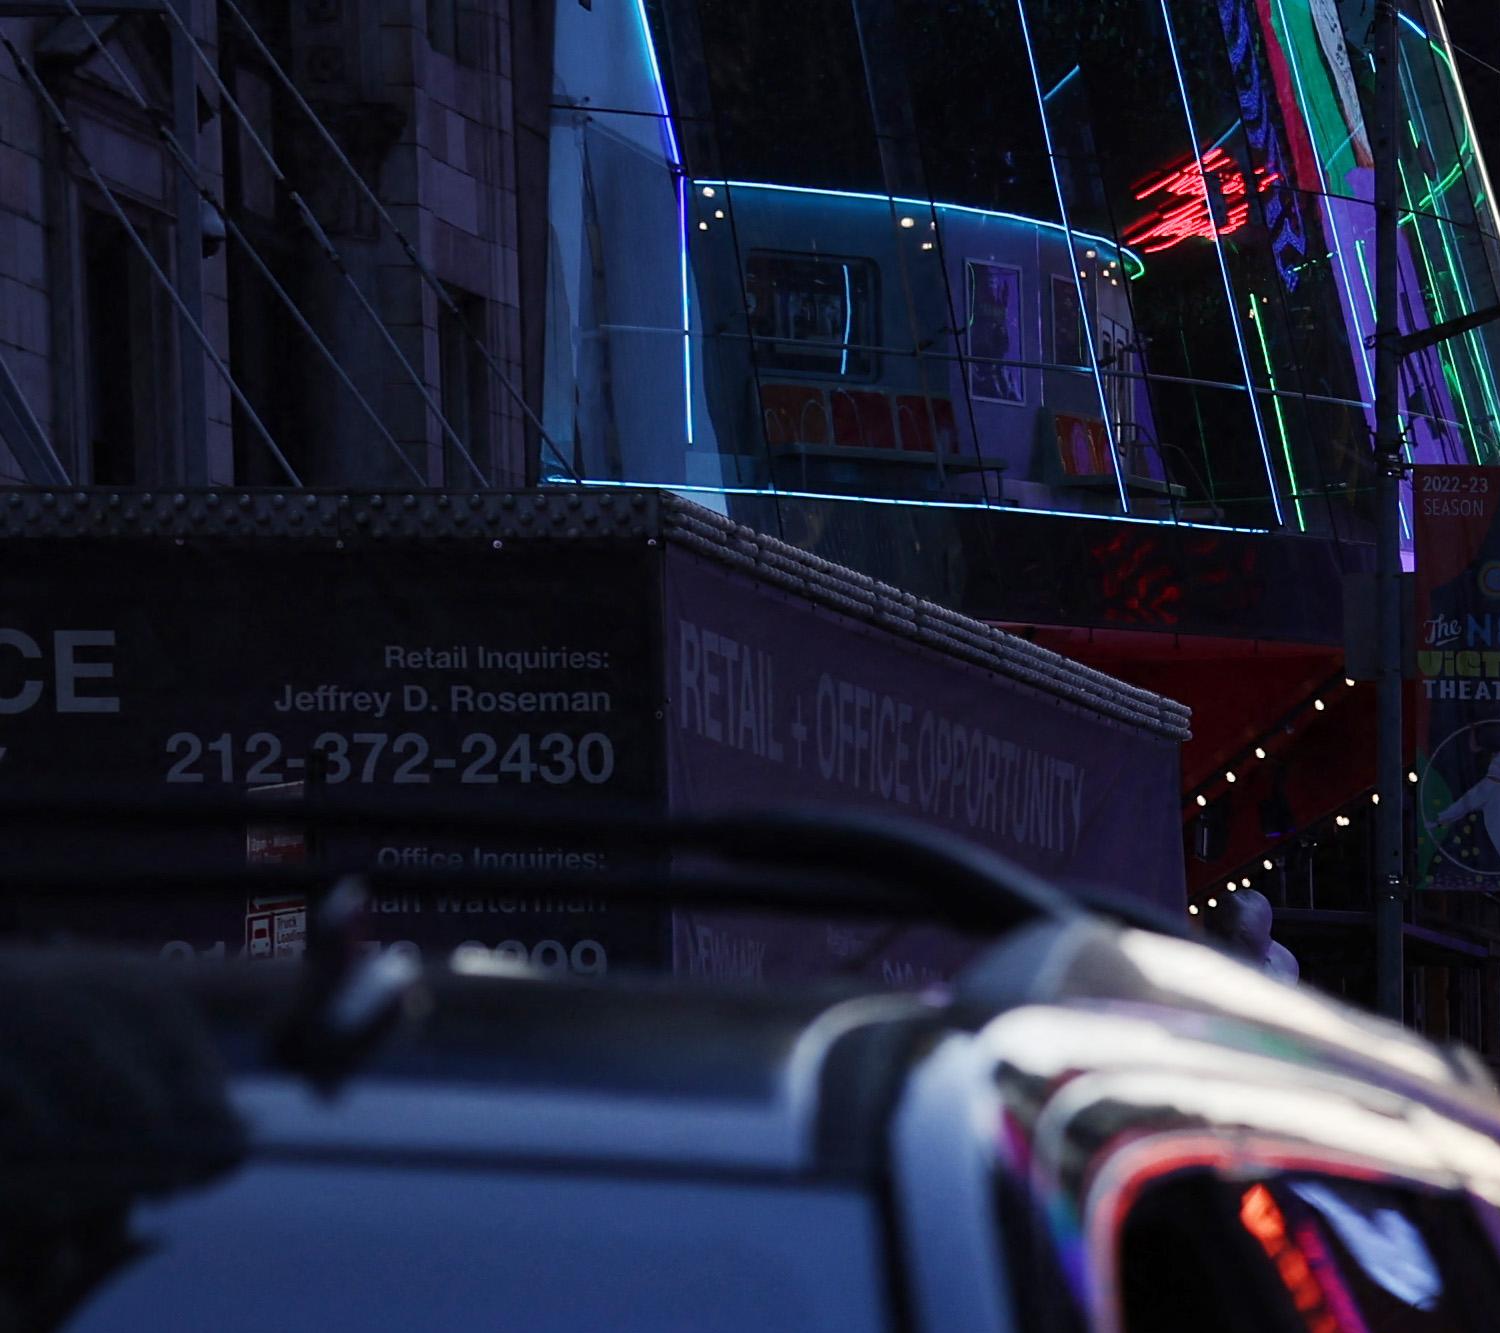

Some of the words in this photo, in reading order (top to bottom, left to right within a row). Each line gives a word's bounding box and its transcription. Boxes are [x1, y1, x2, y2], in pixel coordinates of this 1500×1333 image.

[1422, 475, 1489, 493] 2022-23
[1423, 499, 1484, 517] SEASON
[1423, 614, 1466, 647] The
[384, 645, 469, 670] Retail
[478, 645, 610, 673] Inquiries:
[274, 685, 391, 717] Jeffrey
[404, 685, 438, 713] D.
[451, 685, 612, 713] Roseman
[680, 620, 784, 762] RETAIL
[816, 672, 914, 805] OFFICE
[917, 709, 1086, 857] OPPORTUNITY
[165, 731, 615, 785] 212-372-2430
[377, 847, 464, 871] Office
